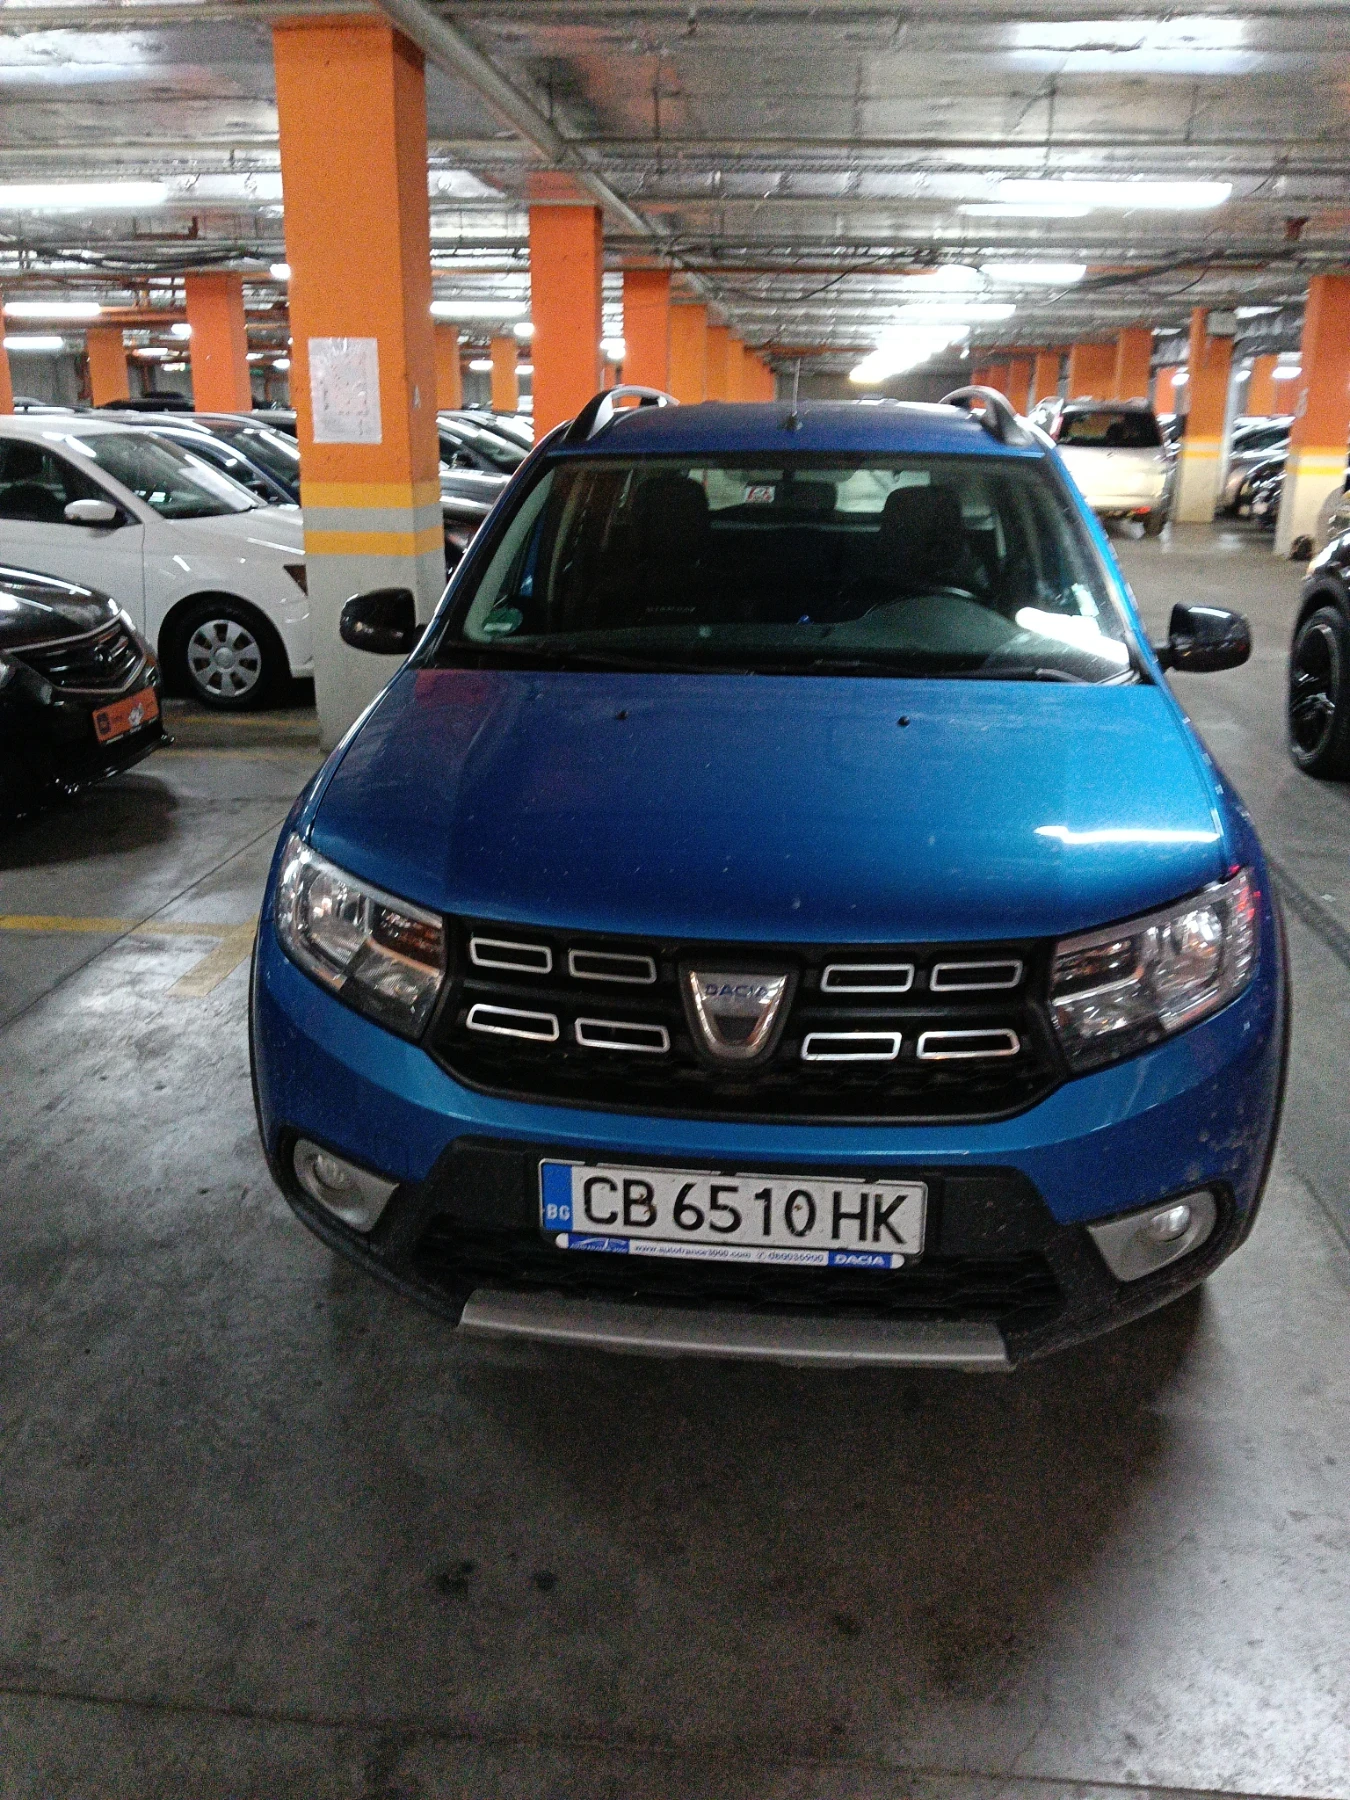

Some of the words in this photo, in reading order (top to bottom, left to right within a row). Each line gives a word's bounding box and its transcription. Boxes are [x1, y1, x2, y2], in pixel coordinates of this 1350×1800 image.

[704, 983, 769, 998] DACIA
[546, 1203, 571, 1222] BG
[583, 1175, 658, 1228] CB
[673, 1181, 817, 1239] 6510
[831, 1190, 909, 1245] HK
[833, 1253, 885, 1267] DACIA
